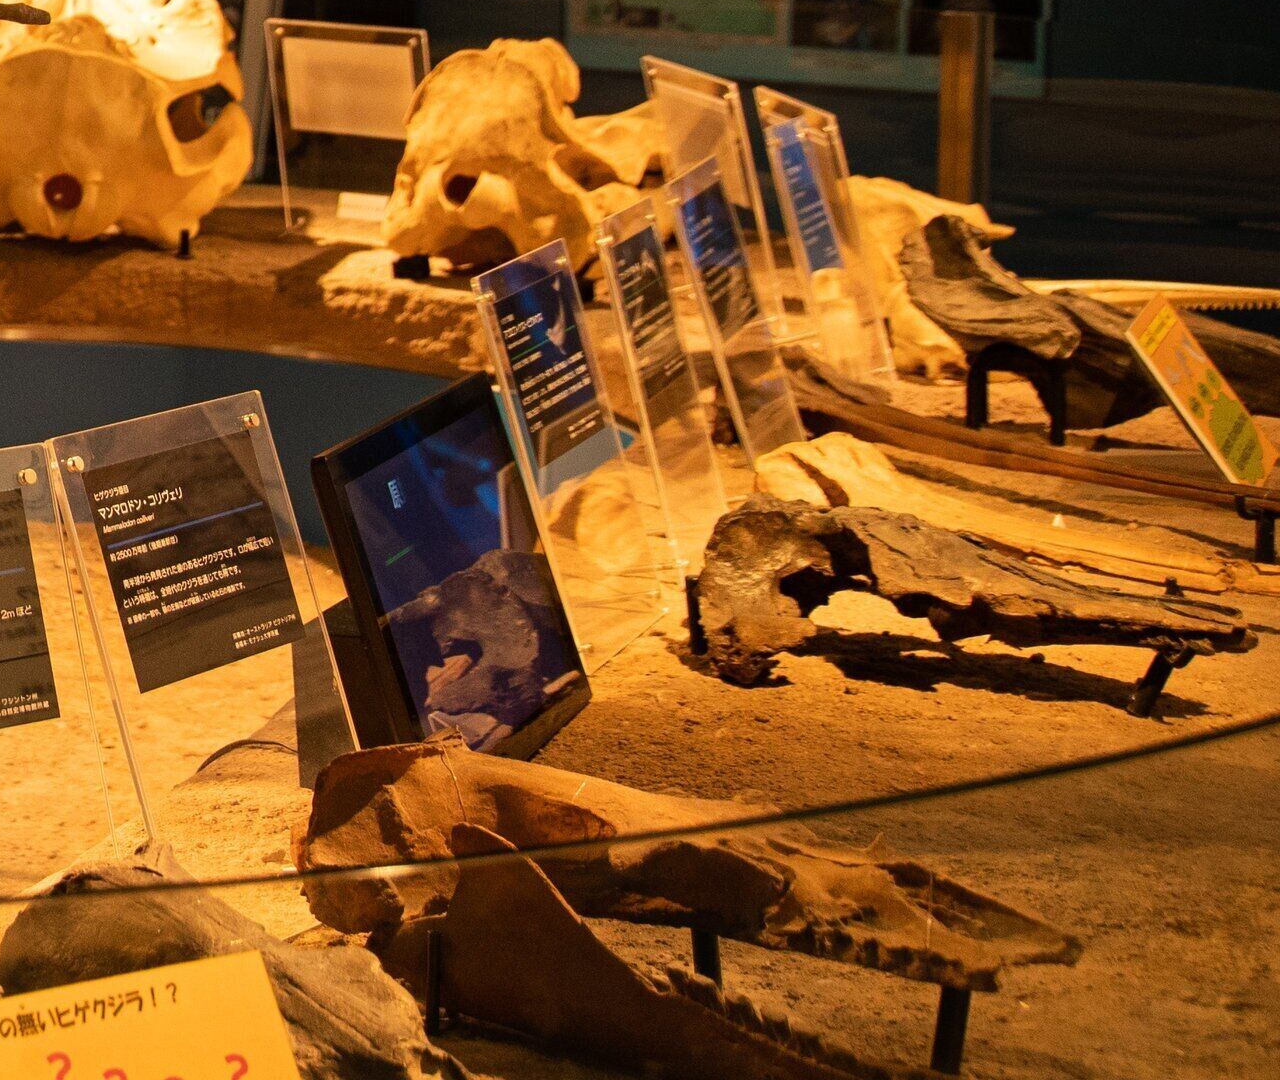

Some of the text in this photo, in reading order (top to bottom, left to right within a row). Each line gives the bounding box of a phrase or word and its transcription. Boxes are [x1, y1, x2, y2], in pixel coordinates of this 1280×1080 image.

[97, 485, 183, 520] マンマロドン・コリヴェリ
